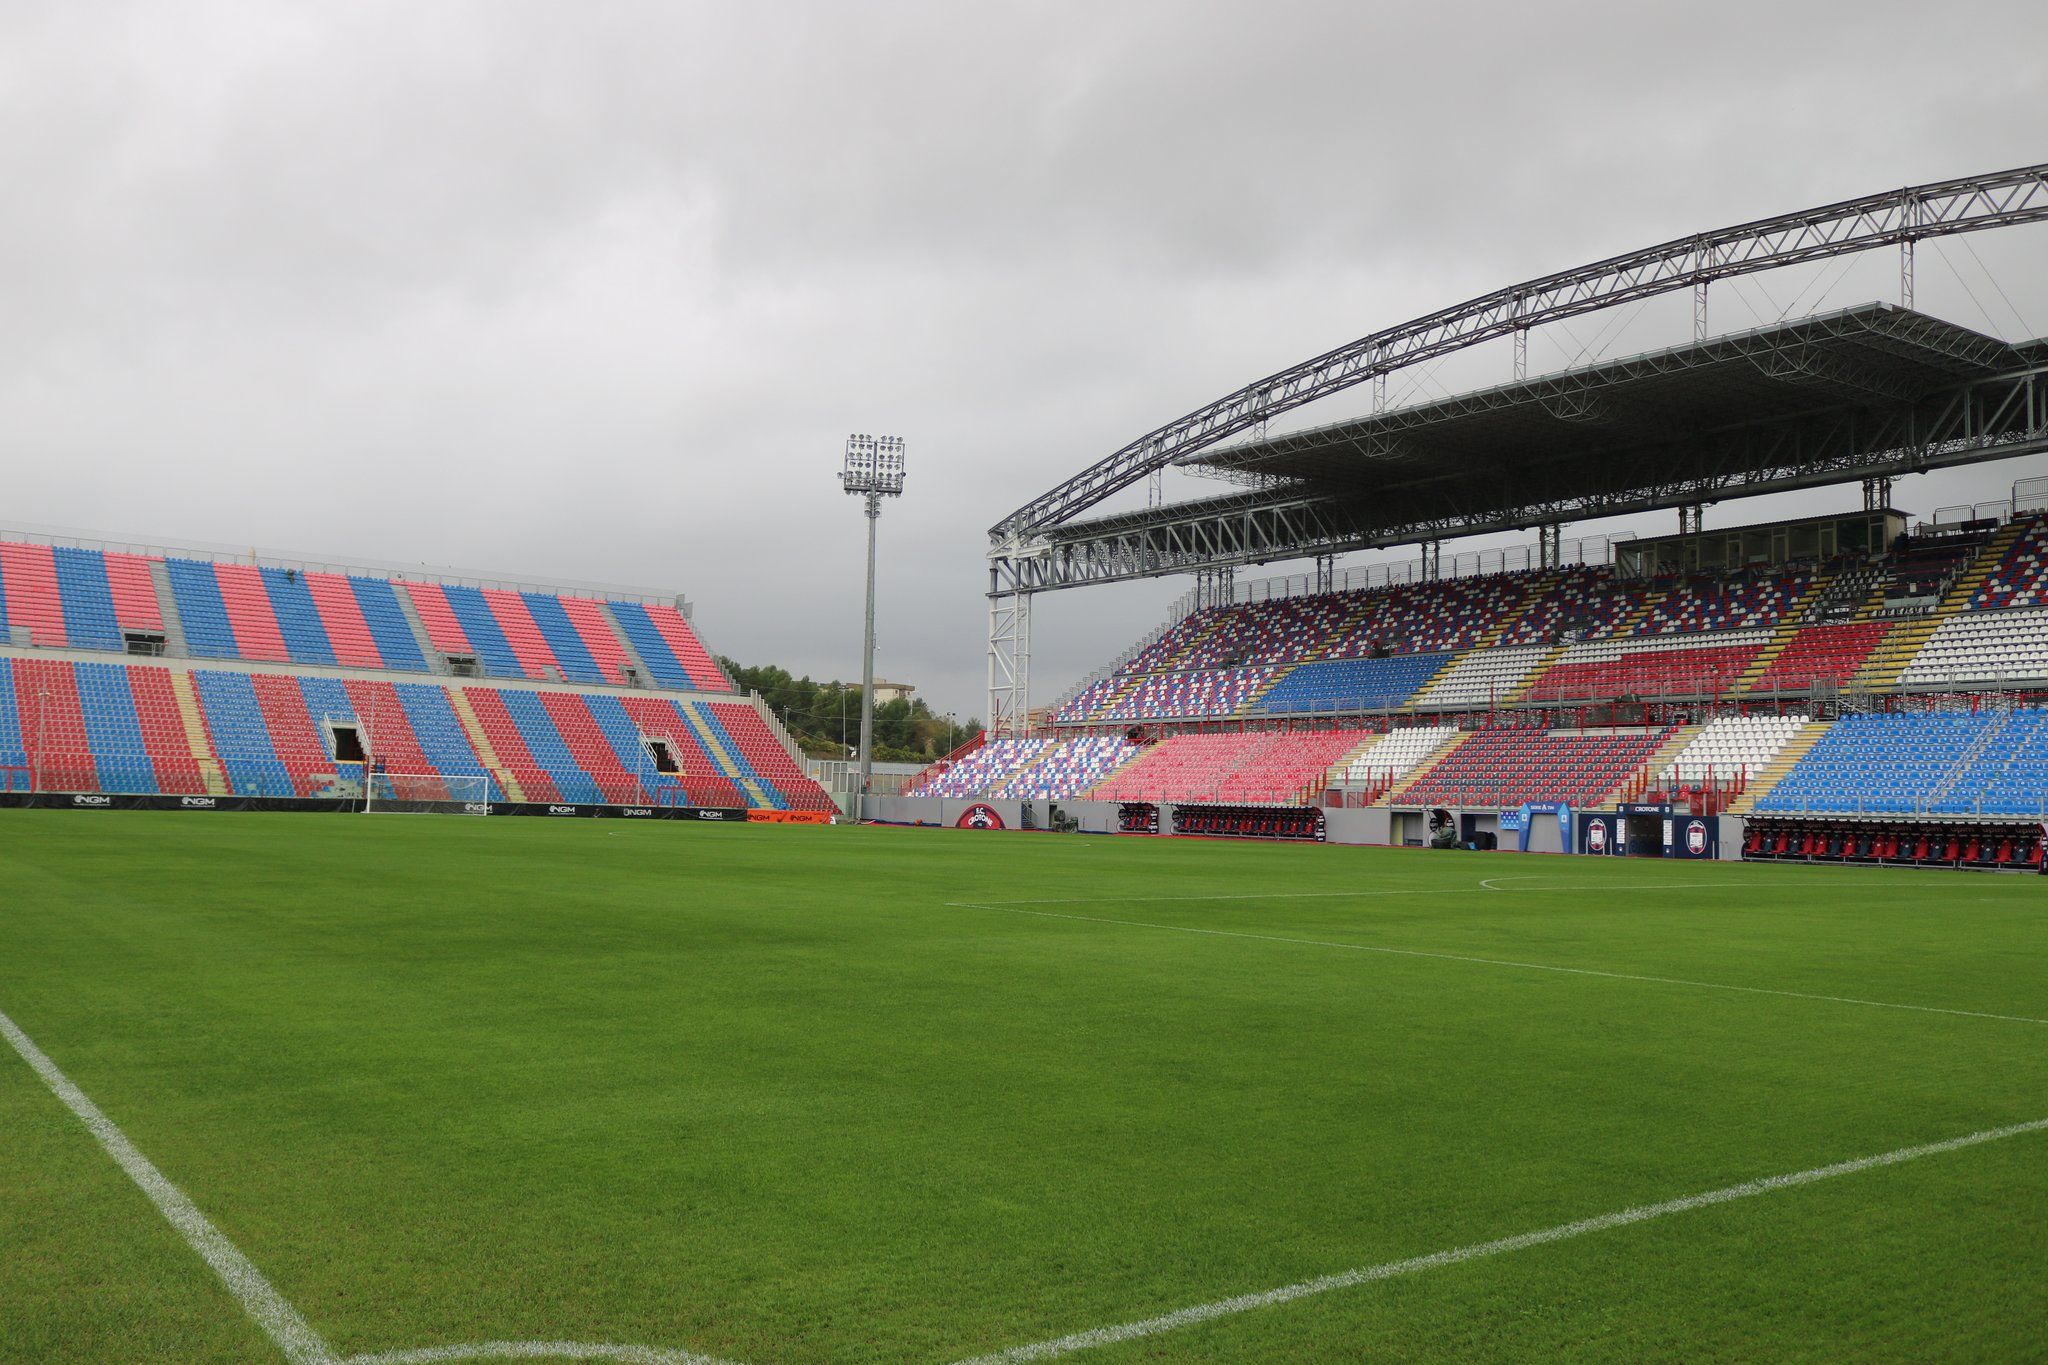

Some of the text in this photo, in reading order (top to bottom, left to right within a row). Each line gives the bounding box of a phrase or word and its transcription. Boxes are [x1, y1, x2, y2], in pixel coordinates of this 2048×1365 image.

[80, 796, 110, 804] NGM
[186, 797, 215, 805] NGM
[469, 803, 493, 811] NGM
[968, 814, 993, 827] CROTONE
